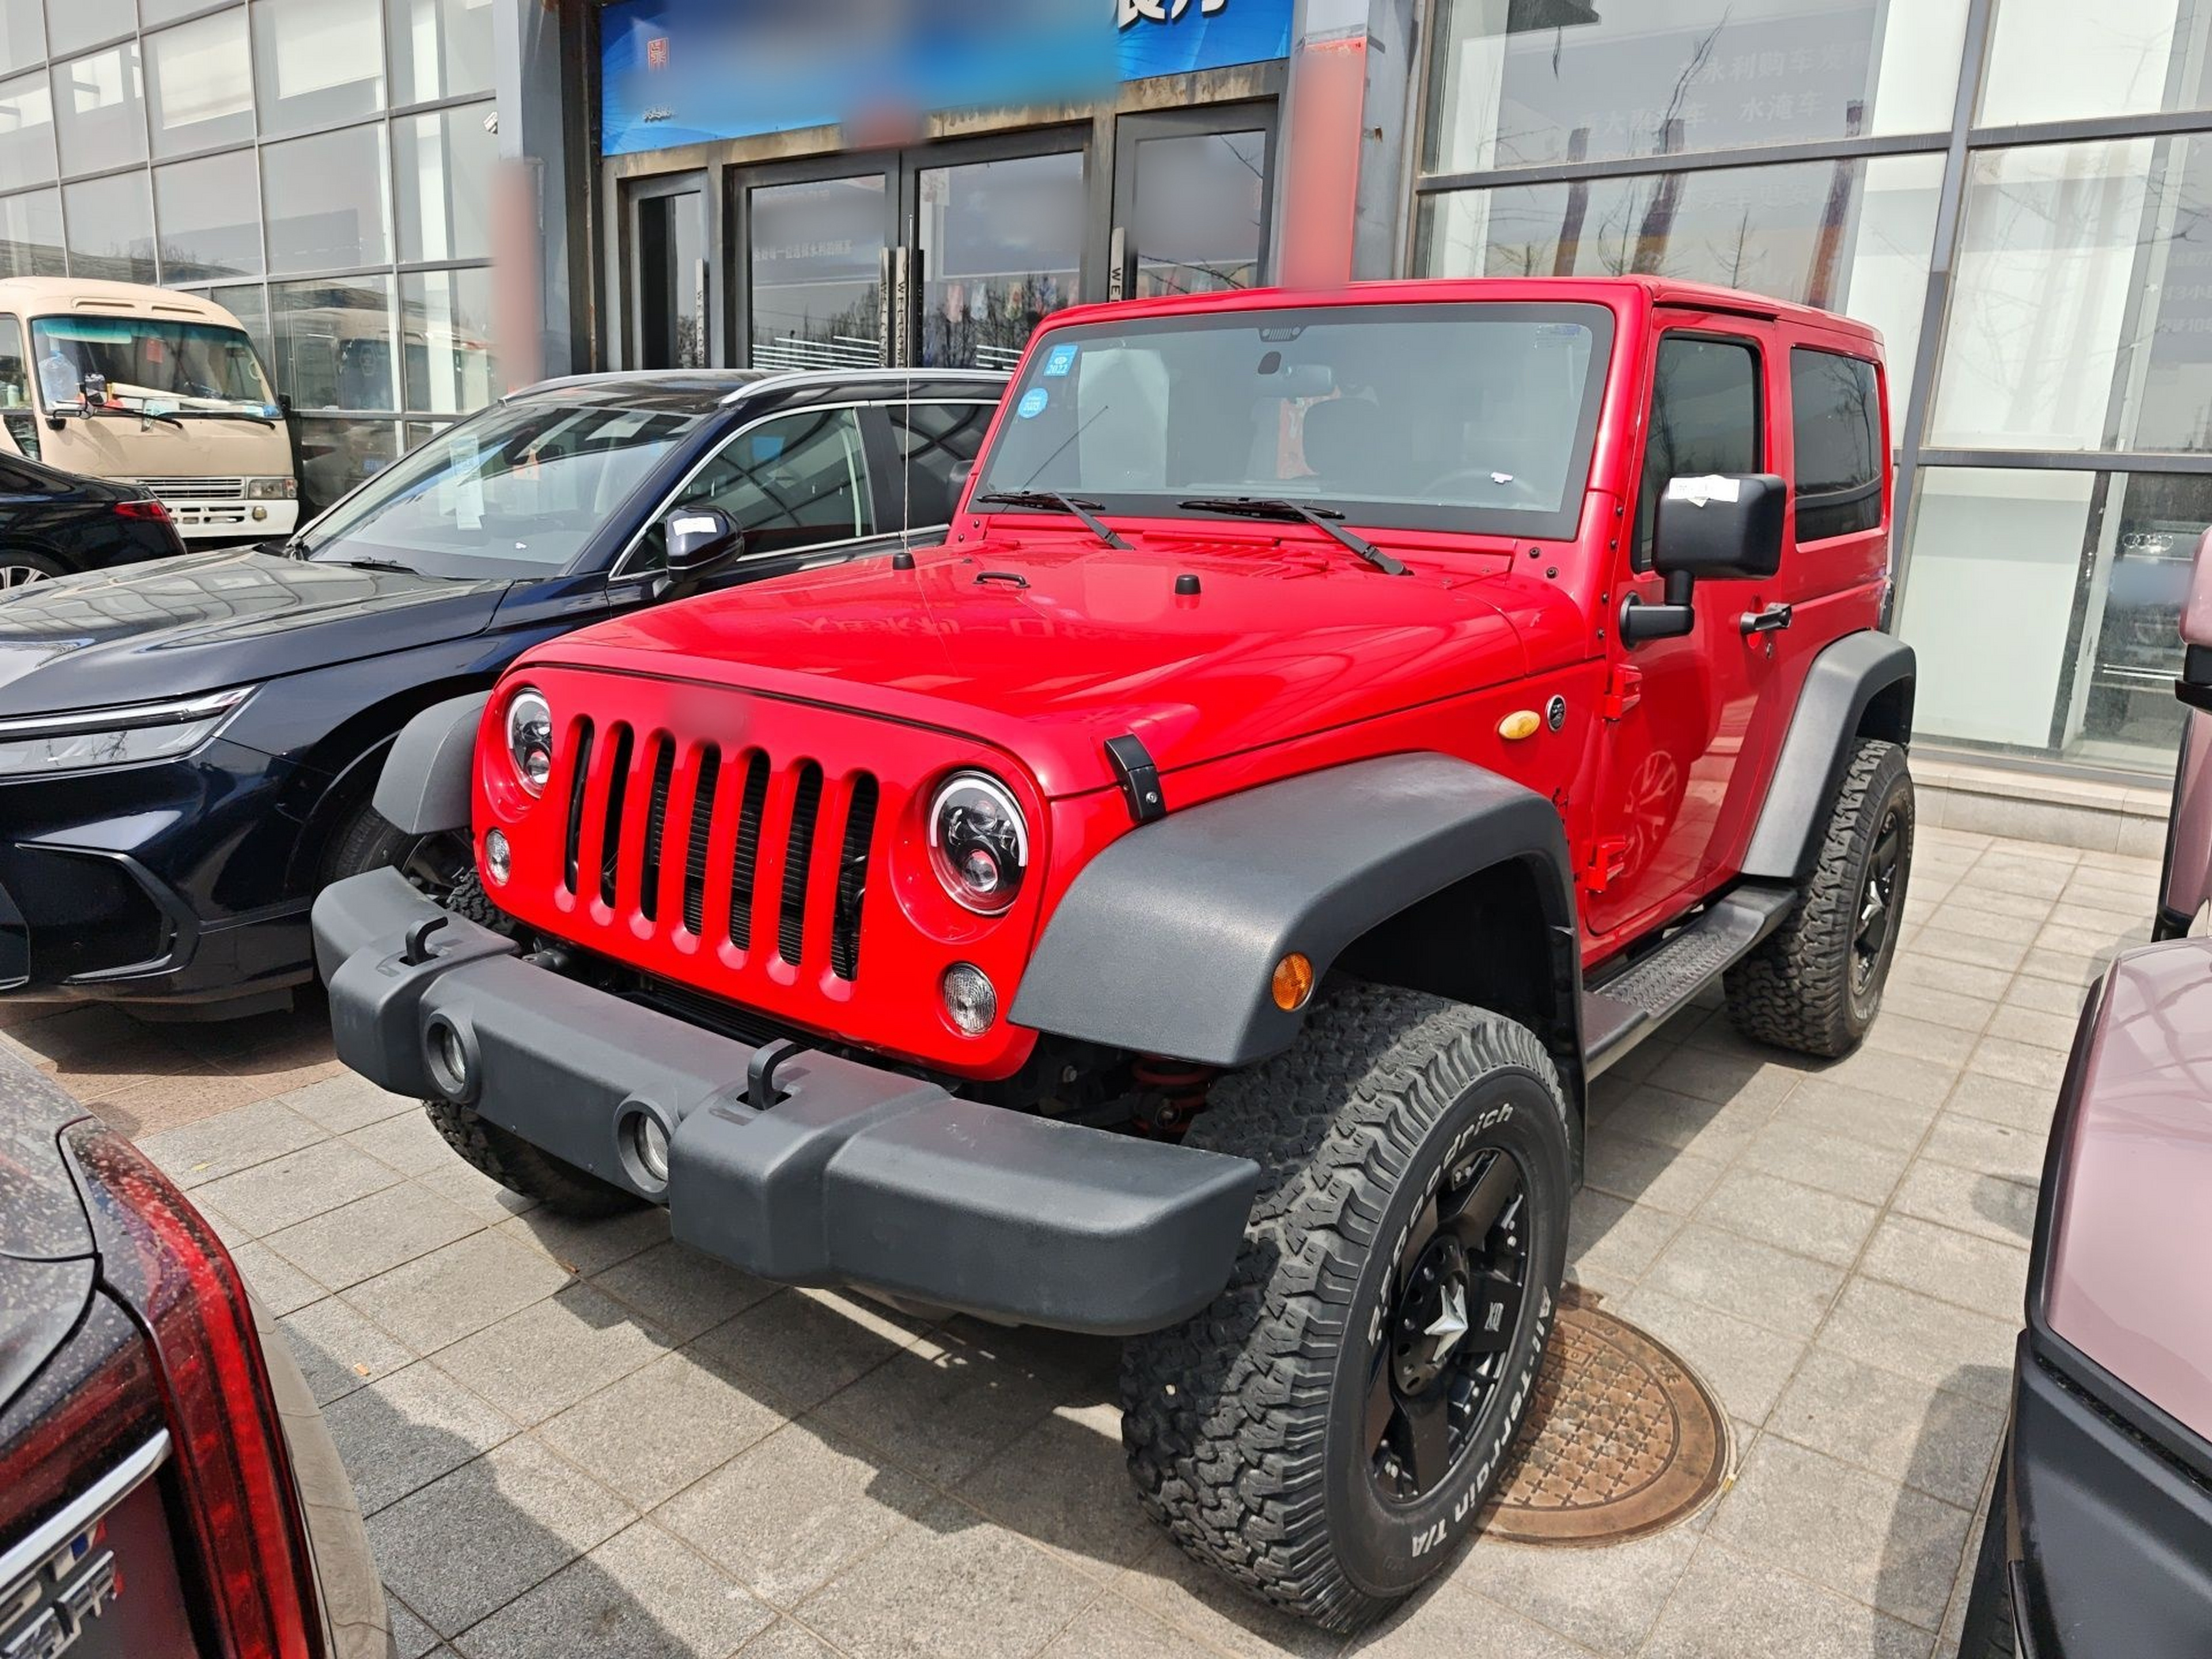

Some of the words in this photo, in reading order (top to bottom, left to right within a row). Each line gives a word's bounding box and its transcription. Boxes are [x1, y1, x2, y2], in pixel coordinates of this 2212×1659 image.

[1673, 43, 1864, 85] 永利购车发
[1454, 1285, 1551, 1522] All-Terrain
[1411, 1518, 1448, 1558] T/A
